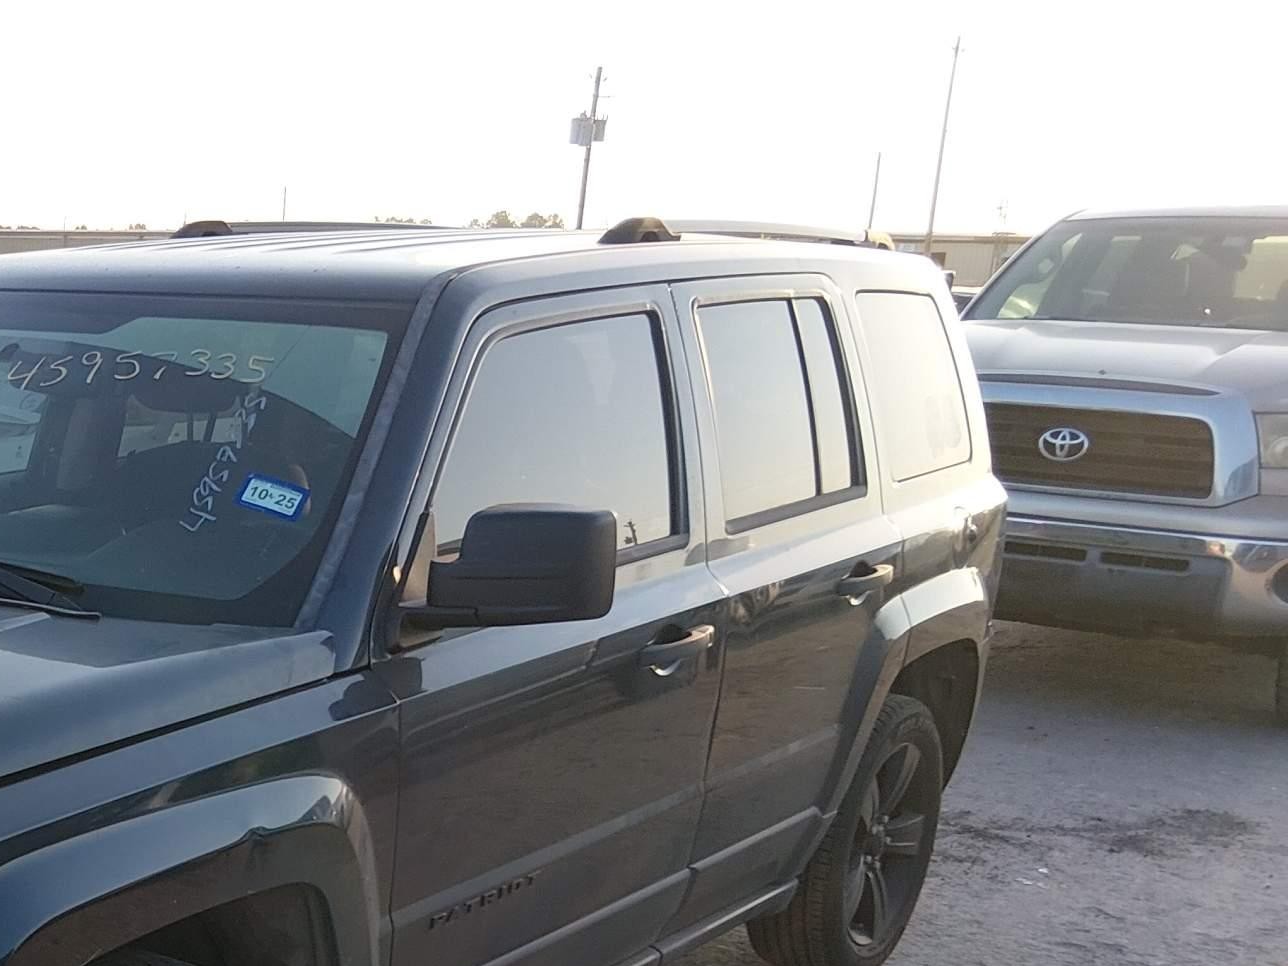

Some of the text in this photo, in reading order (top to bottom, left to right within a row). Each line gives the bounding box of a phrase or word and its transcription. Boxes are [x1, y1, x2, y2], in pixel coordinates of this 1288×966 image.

[7, 348, 274, 391] 45957335
[250, 486, 269, 501] 10
[274, 493, 297, 509] 25
